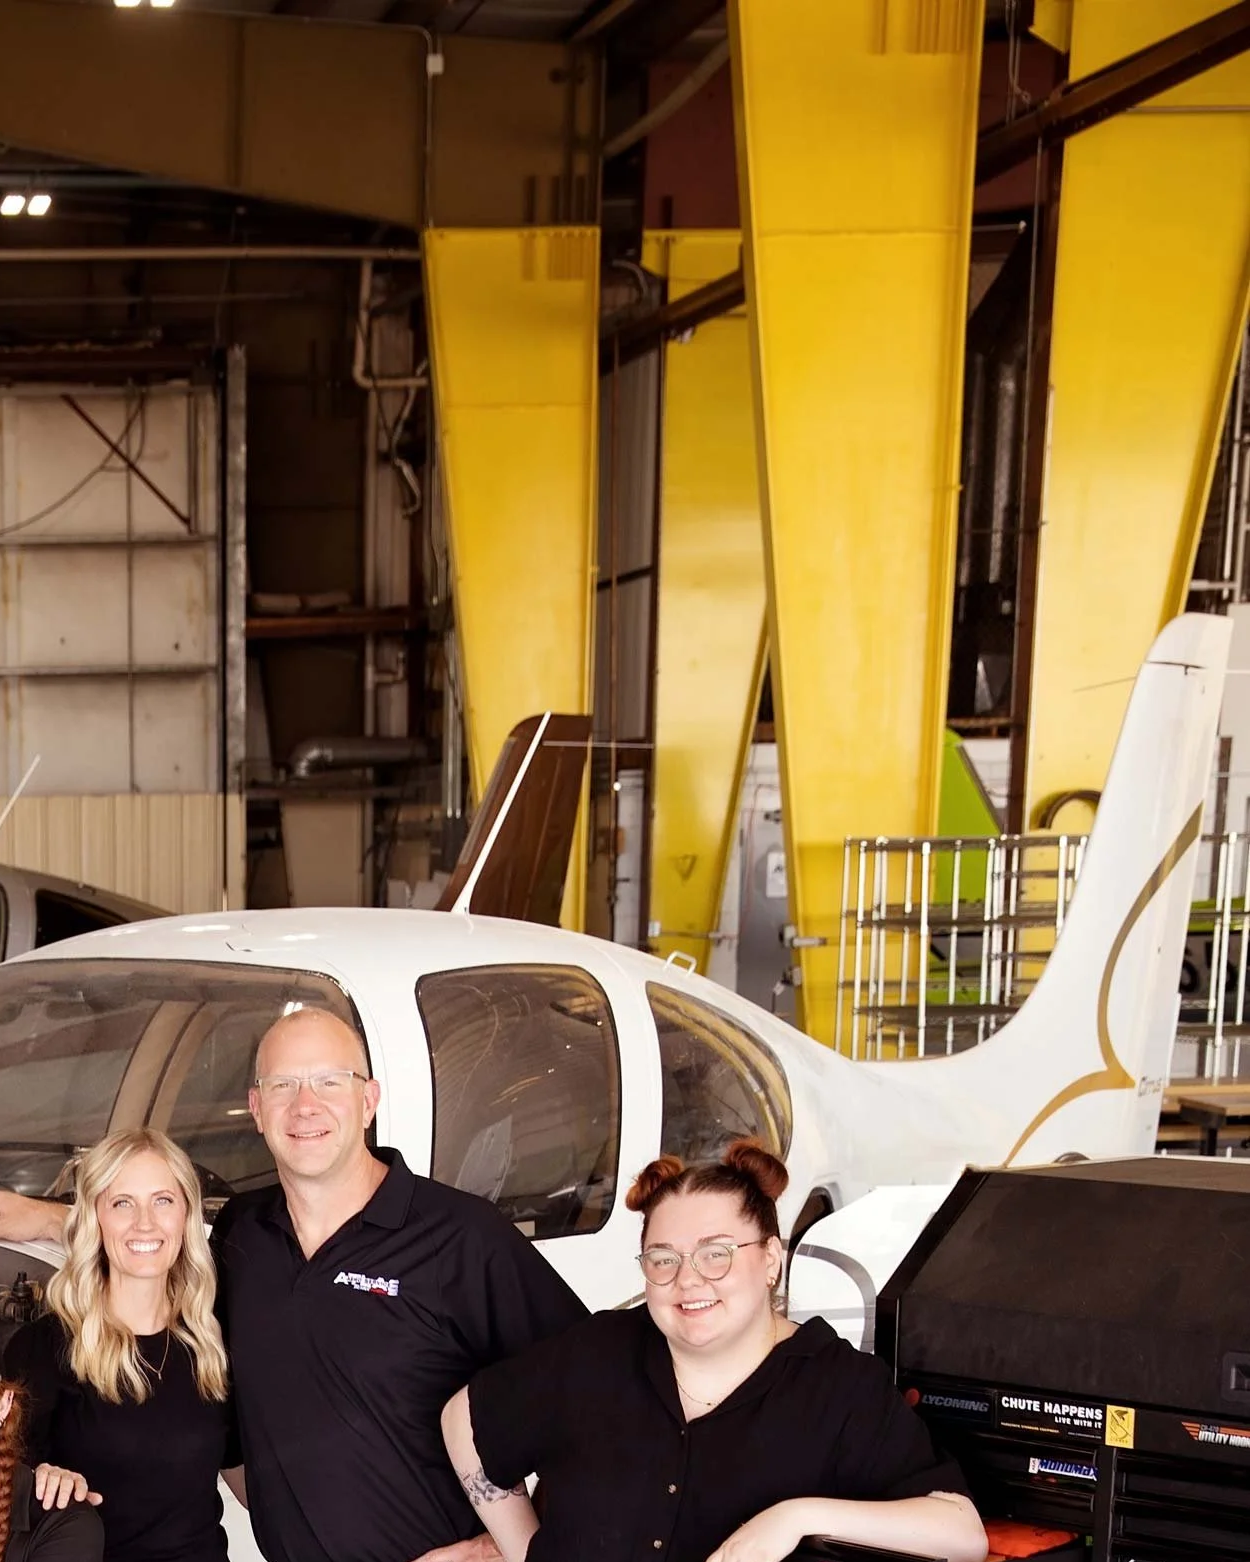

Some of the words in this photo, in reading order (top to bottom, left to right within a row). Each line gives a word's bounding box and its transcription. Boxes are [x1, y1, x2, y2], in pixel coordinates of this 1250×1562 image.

[922, 1394, 990, 1413] LYCOMING
[1001, 1396, 1041, 1413] CHUTE
[1043, 1402, 1103, 1421] HAPPENS
[1054, 1416, 1071, 1425] LIVE
[1072, 1418, 1093, 1428] WITH
[1094, 1421, 1103, 1429] IT
[1198, 1430, 1229, 1445] UTILITY
